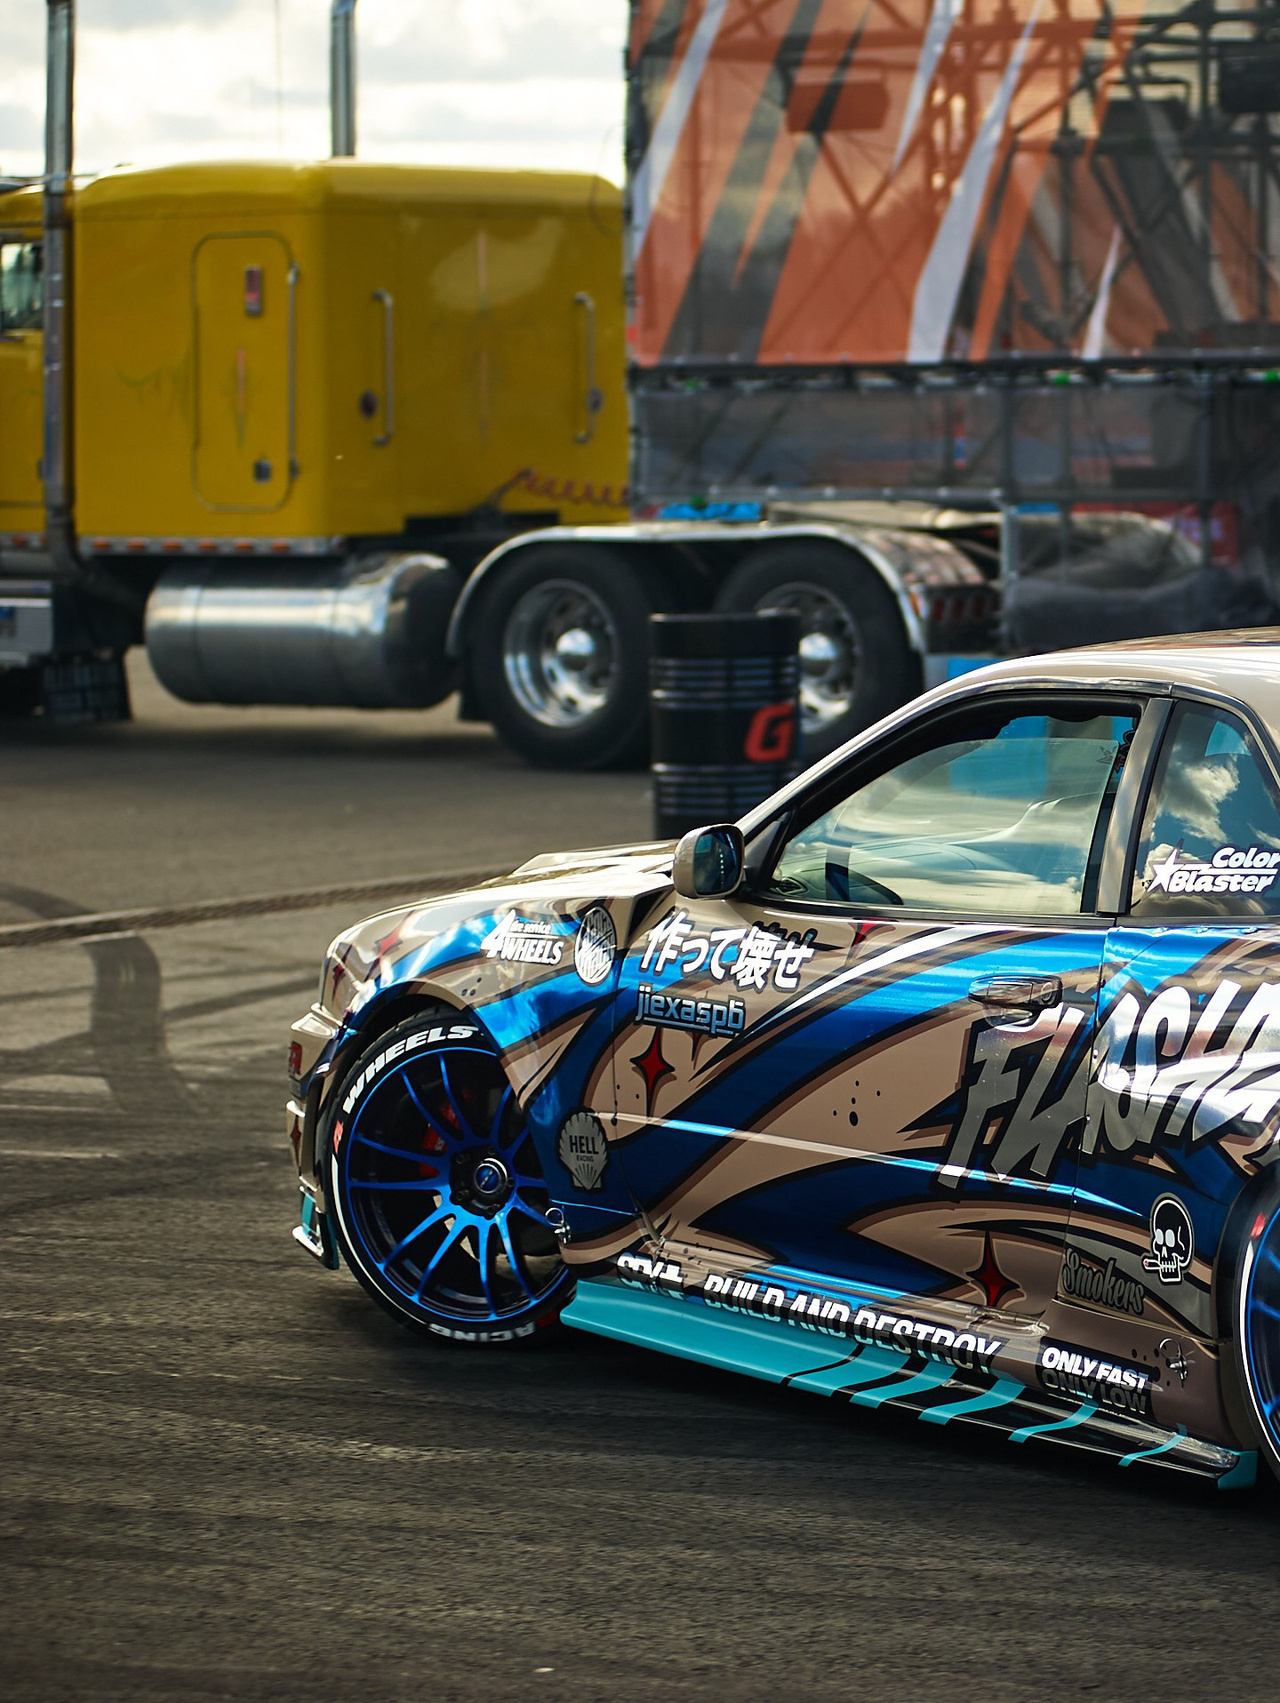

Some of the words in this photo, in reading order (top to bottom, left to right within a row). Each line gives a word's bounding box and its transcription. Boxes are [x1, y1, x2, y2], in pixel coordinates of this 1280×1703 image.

[1168, 870, 1276, 893] Blaster
[480, 908, 517, 959] 4
[500, 937, 565, 965] WHEELS
[523, 920, 552, 935] service
[640, 910, 818, 989] 作って壊せ
[342, 1025, 480, 1114] WHEELS
[569, 1134, 599, 1154] HELL
[1062, 1247, 1145, 1314] Smokers
[703, 1273, 786, 1323] BUILD
[787, 1294, 850, 1339] AND
[853, 1308, 1002, 1374] DESTROY
[1041, 1346, 1099, 1378] ONLY
[1095, 1361, 1149, 1392] FAST
[1041, 1369, 1098, 1399] ONLY
[1101, 1383, 1148, 1415] LOW
